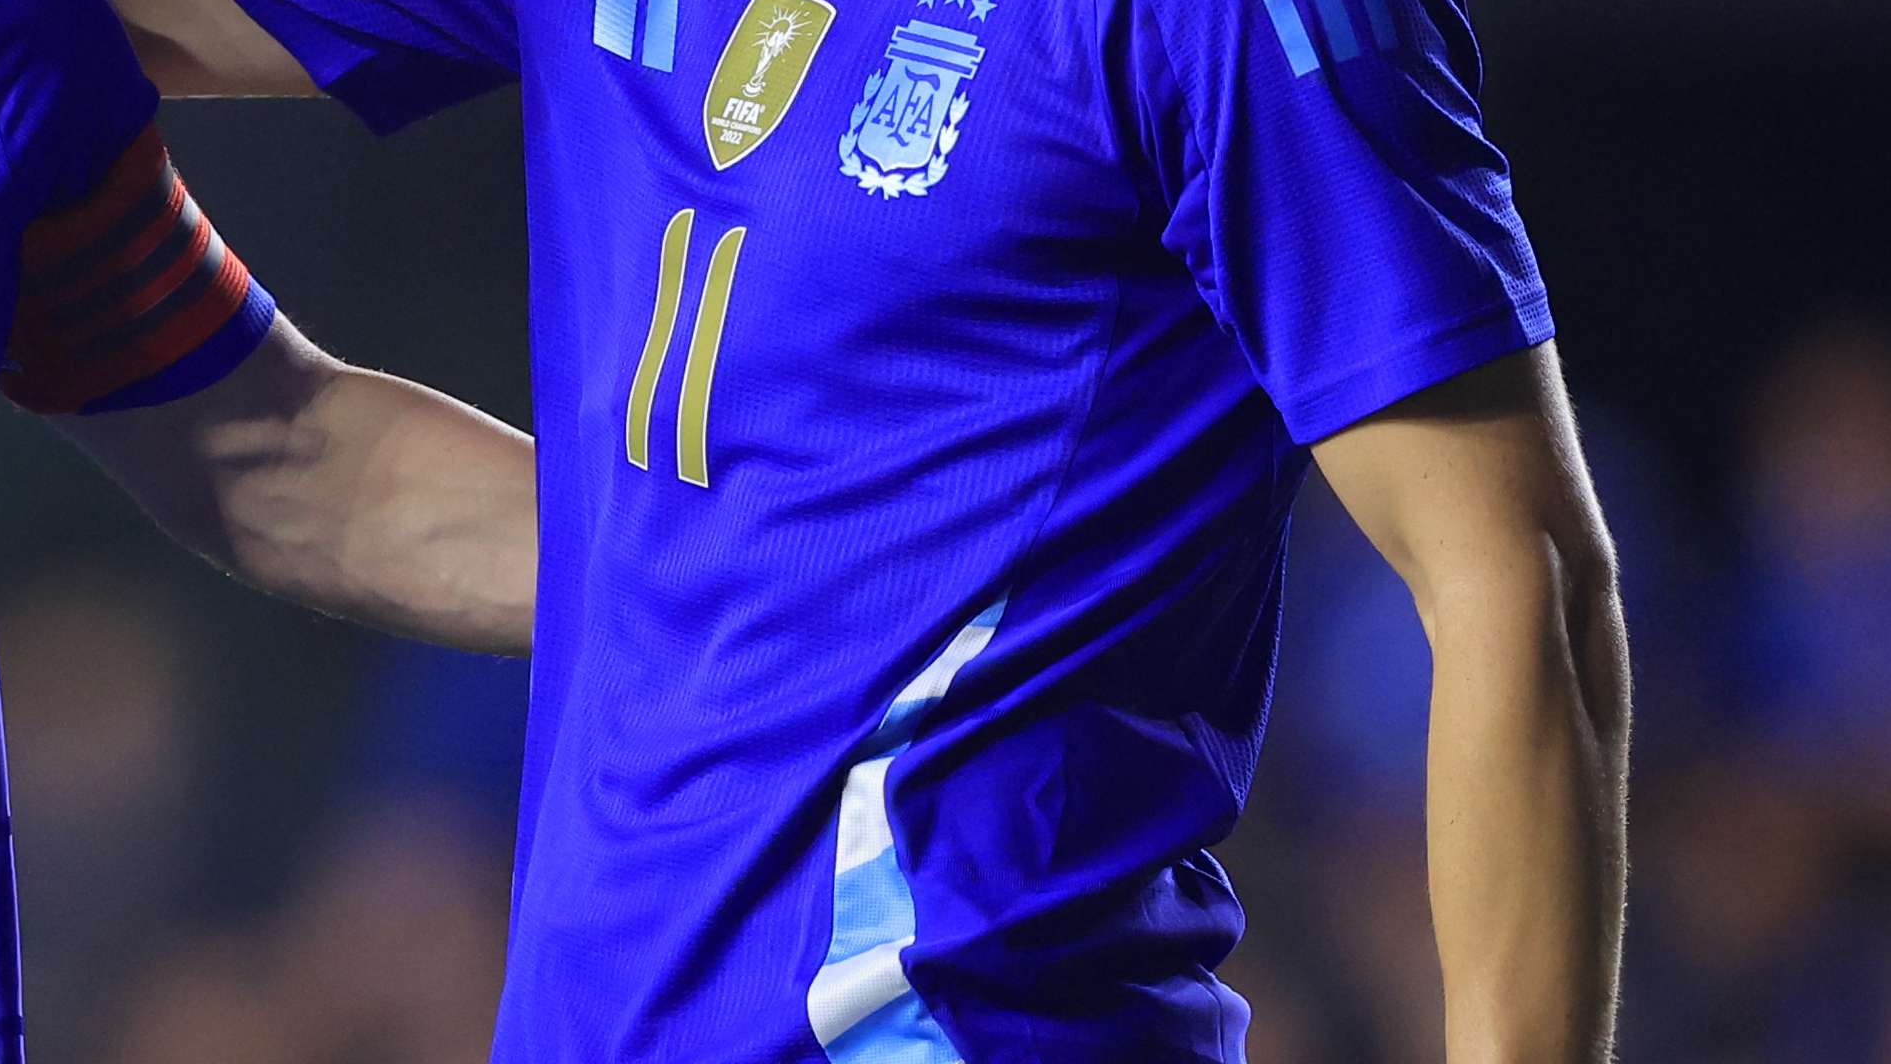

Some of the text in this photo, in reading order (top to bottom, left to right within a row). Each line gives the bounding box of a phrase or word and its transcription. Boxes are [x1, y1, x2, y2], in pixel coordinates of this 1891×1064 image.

[722, 97, 760, 125] FIFA
[871, 65, 940, 147] AFA
[719, 129, 743, 145] 2022
[625, 208, 747, 489] 11
